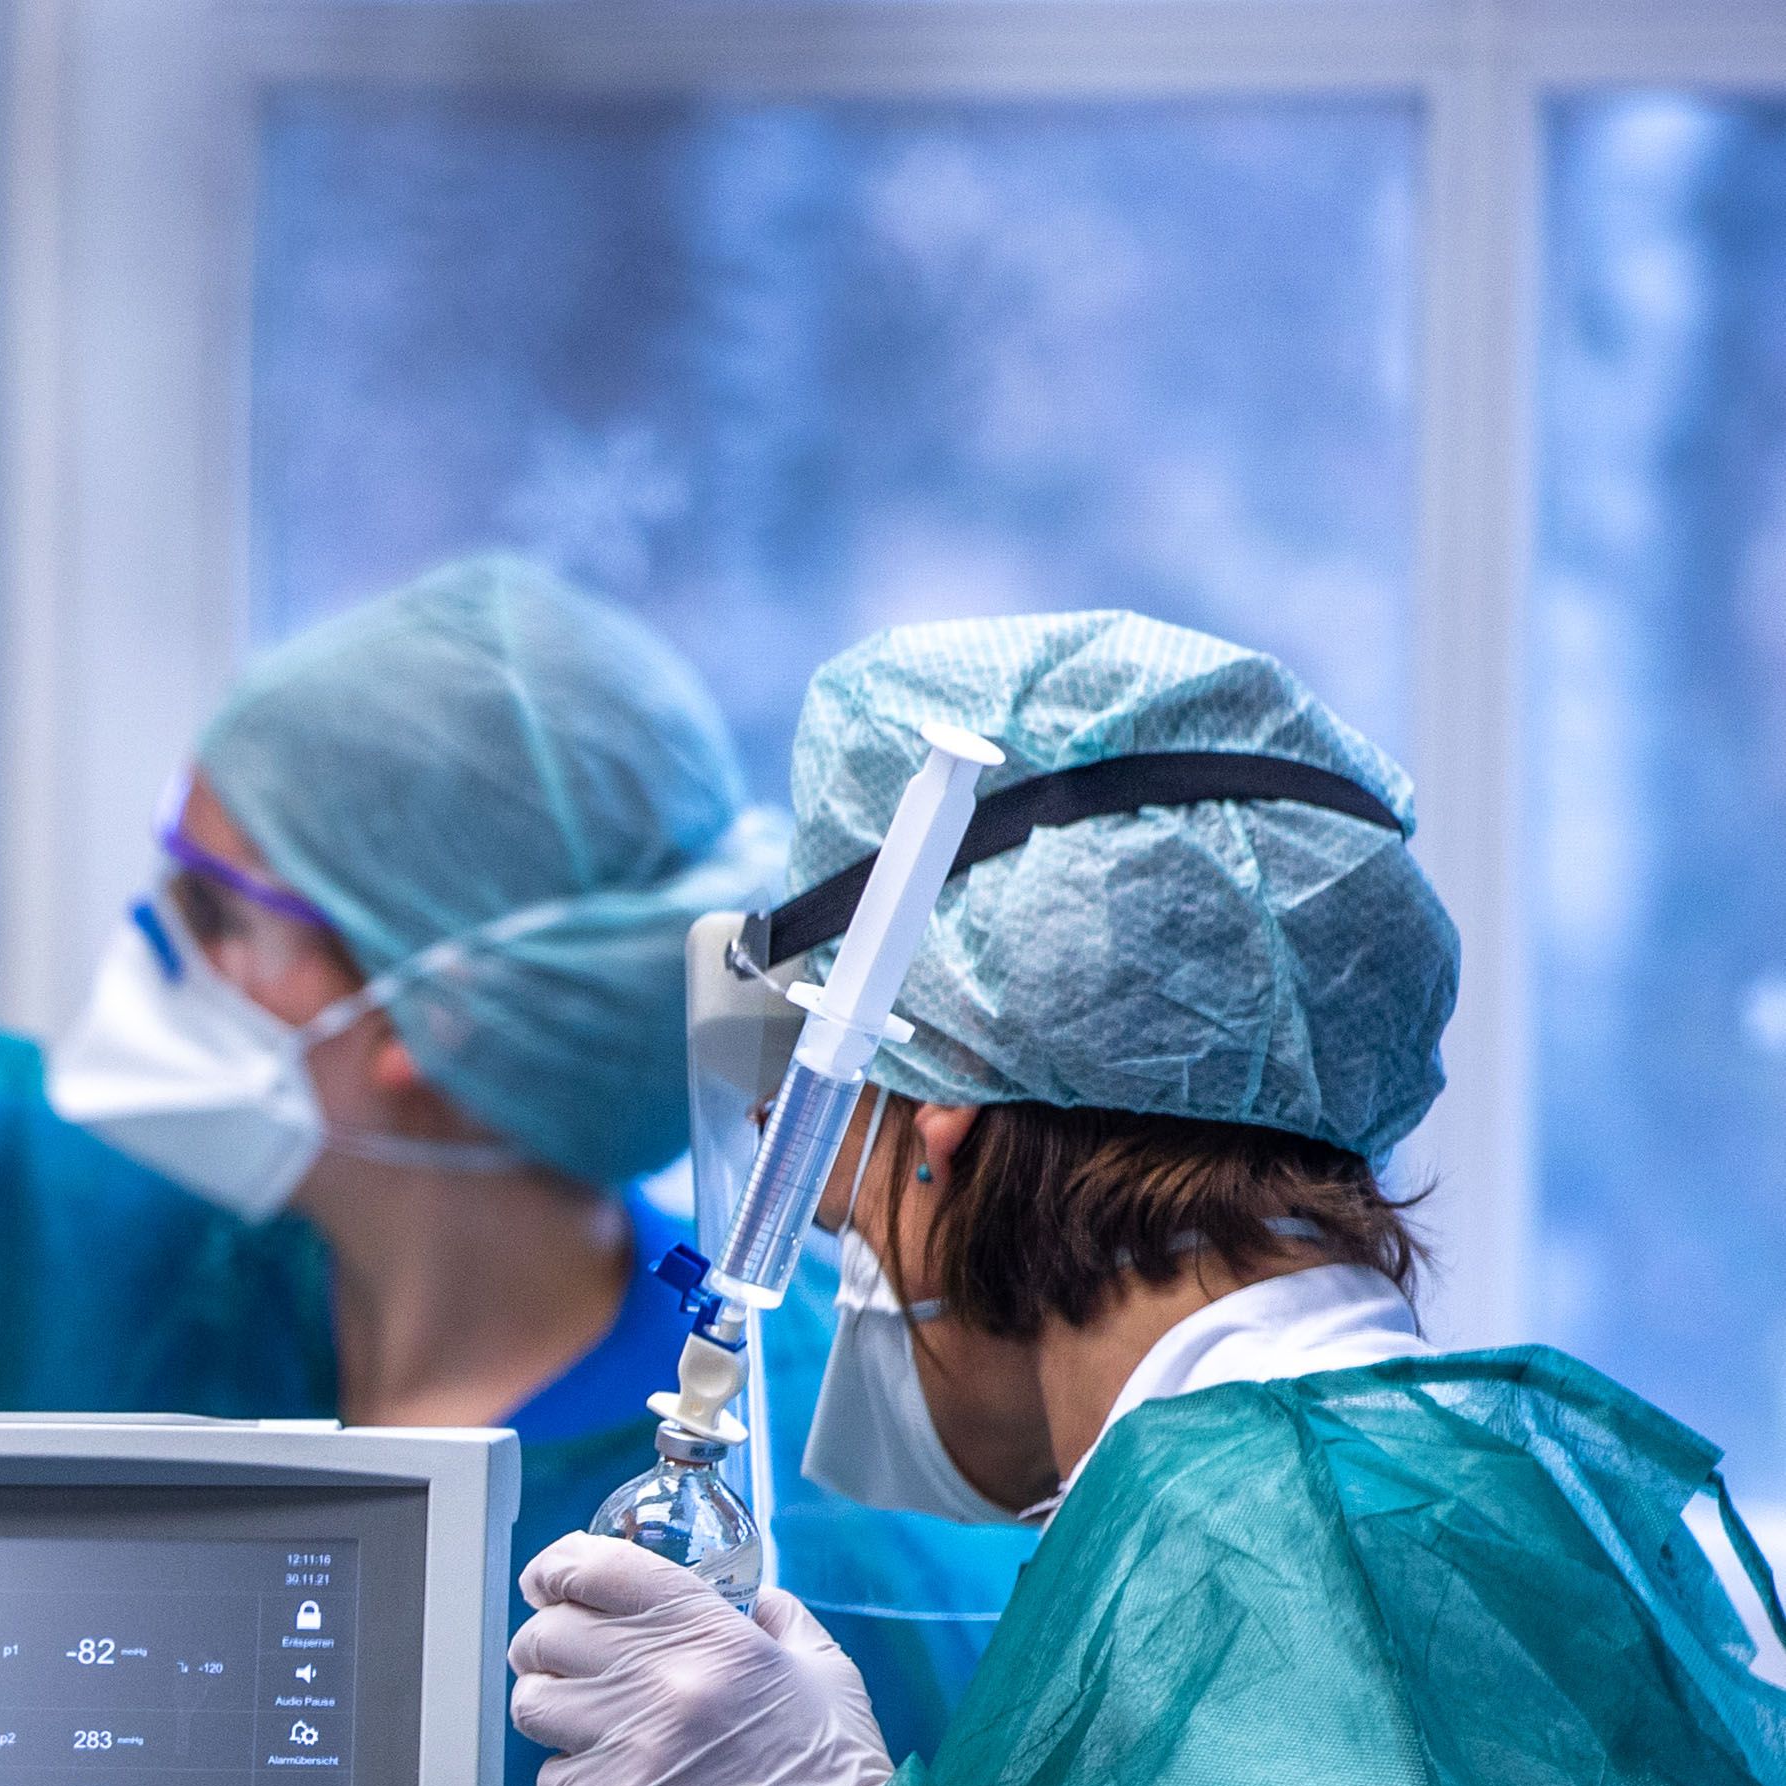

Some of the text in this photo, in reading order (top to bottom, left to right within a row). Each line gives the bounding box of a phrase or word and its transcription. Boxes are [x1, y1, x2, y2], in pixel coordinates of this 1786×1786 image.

[3, 1644, 19, 1657] p1
[66, 1638, 115, 1665] -82
[198, 1662, 223, 1674] -120
[275, 1696, 335, 1707] Audio Pause
[0, 1732, 16, 1746] p2
[73, 1730, 113, 1749] 283
[267, 1755, 339, 1766] Alarmübersicht
